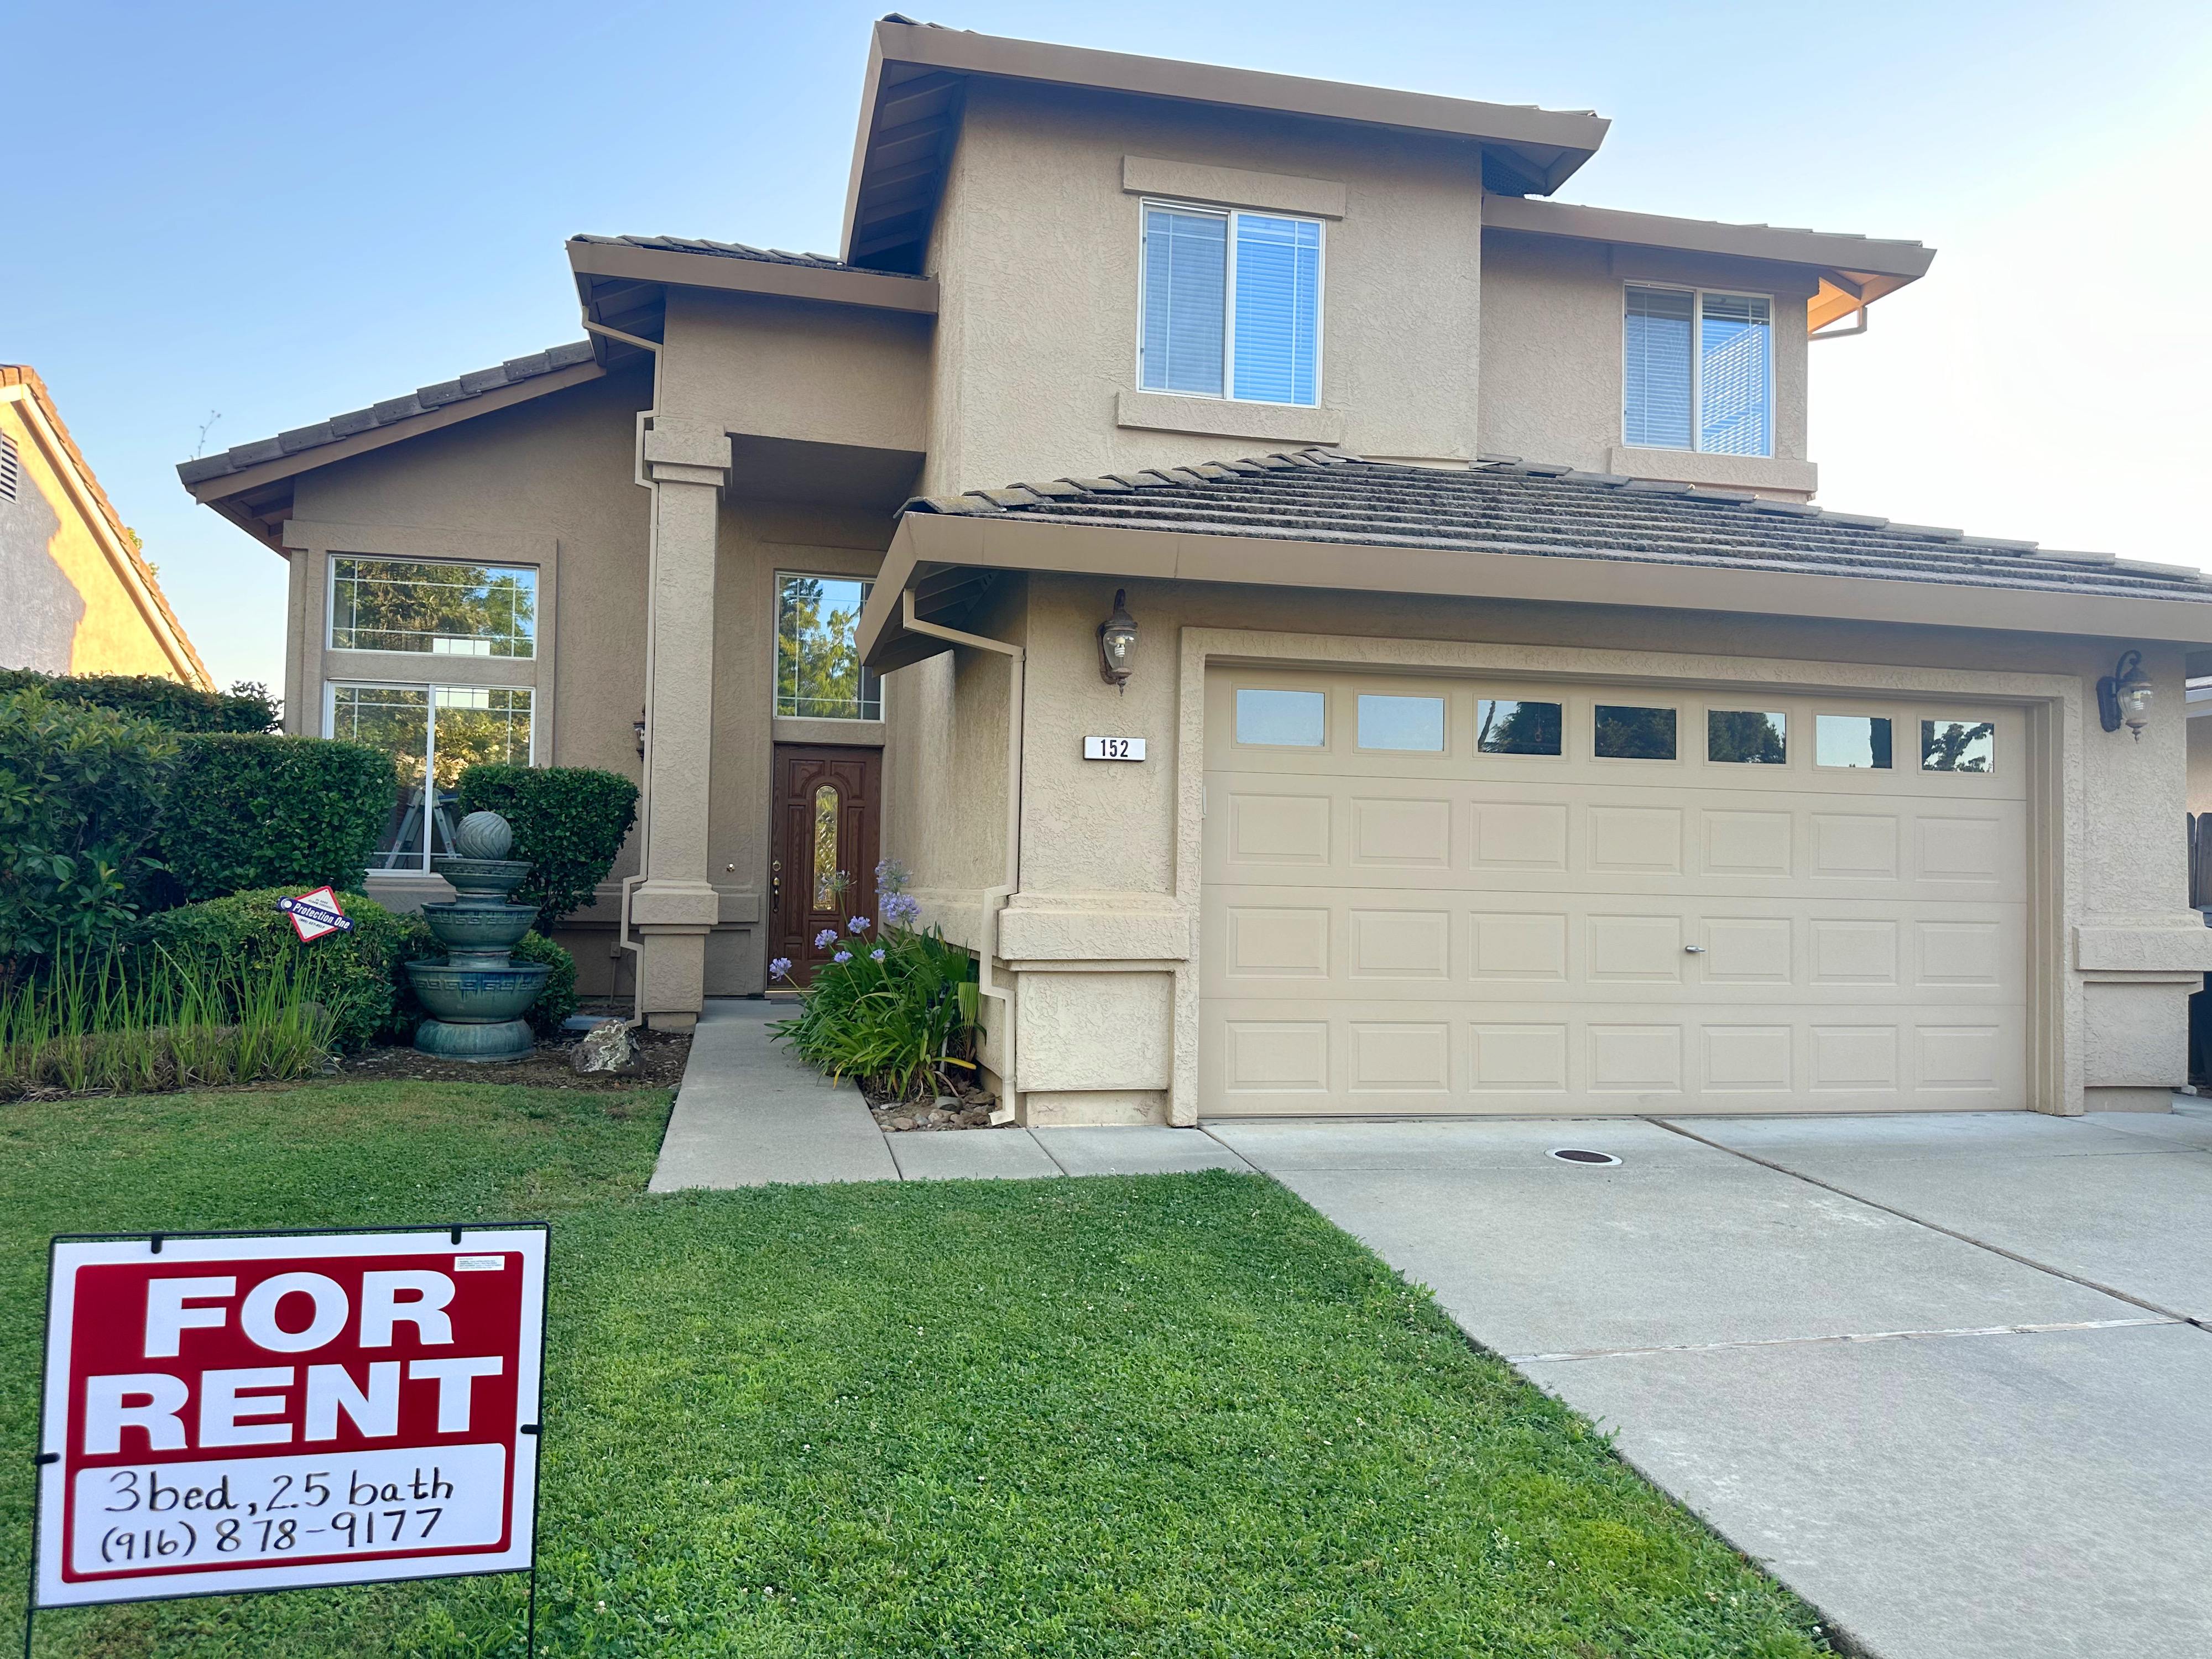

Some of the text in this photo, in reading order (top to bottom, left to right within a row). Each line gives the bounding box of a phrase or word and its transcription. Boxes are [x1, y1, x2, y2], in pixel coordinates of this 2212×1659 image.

[1100, 739, 1129, 758] 152
[293, 902, 335, 924] Protection
[334, 916, 351, 929] One
[144, 1270, 456, 1359] FOR
[84, 1355, 504, 1456] RENT
[349, 1467, 454, 1506] bath
[102, 1507, 443, 1563] (916) 878-9177
